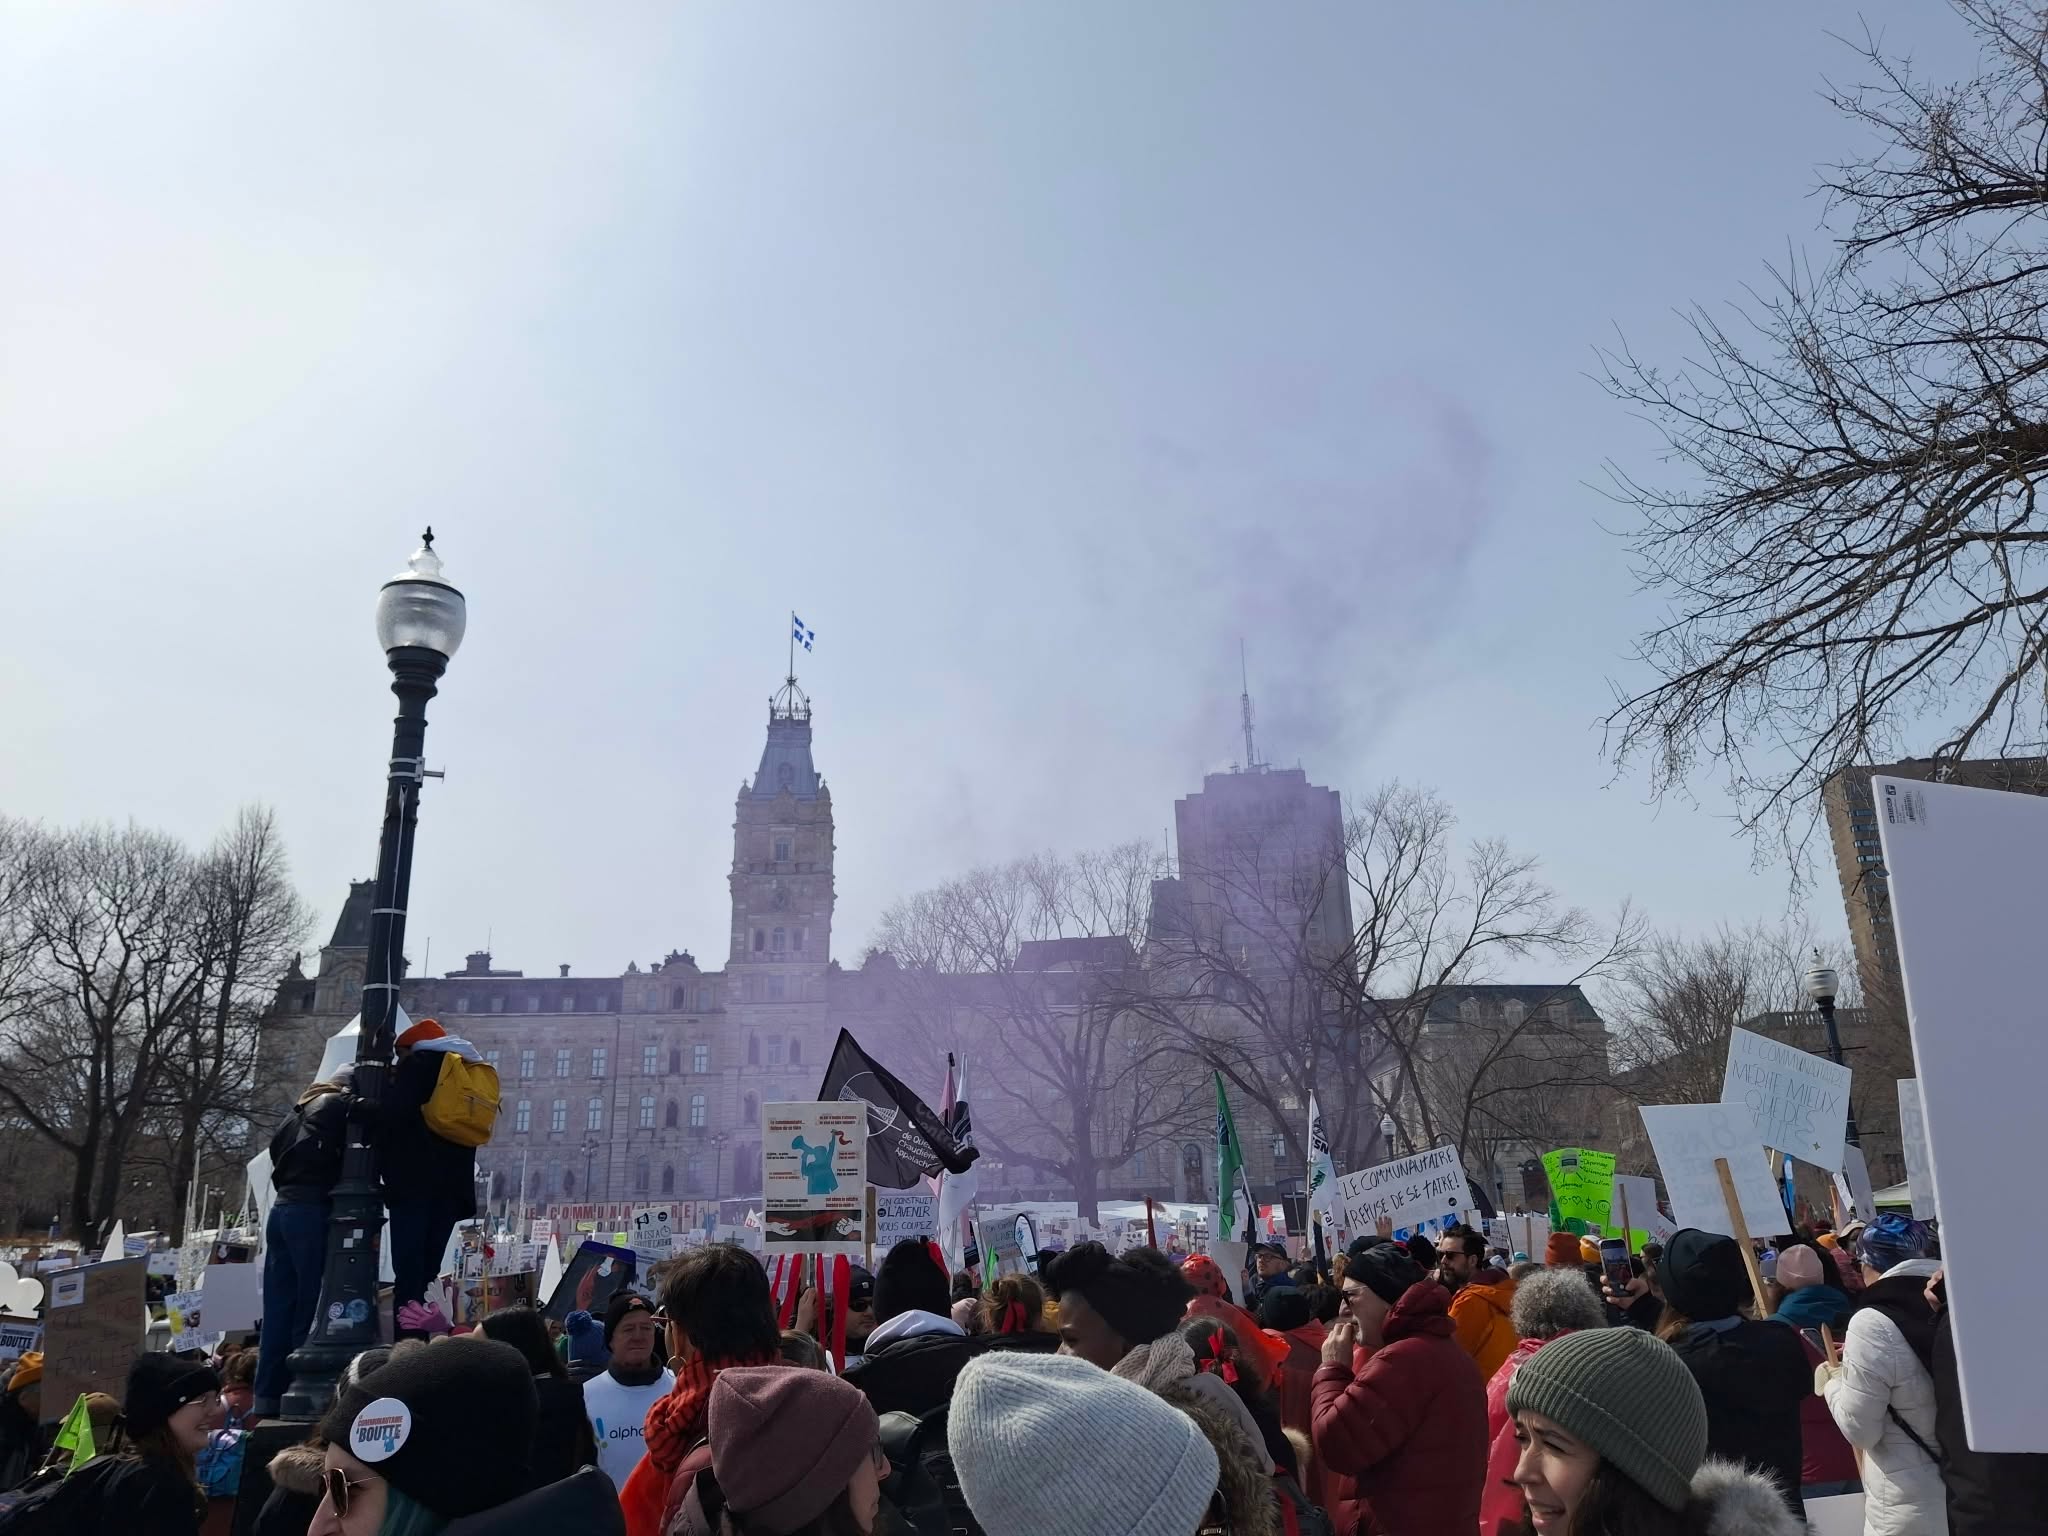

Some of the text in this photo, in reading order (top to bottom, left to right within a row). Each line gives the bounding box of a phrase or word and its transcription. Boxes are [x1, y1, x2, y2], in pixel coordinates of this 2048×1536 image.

[1785, 1079, 1841, 1119] MIEUX
[1343, 1177, 1361, 1201] LE
[1360, 1147, 1454, 1191] COMMUNAUTAIRE
[879, 1196, 933, 1207] ON CONSTRUIT
[1349, 1198, 1389, 1231] REFUSE
[1390, 1191, 1405, 1210] DE
[1405, 1185, 1422, 1202] SE
[525, 1207, 536, 1220] LE
[887, 1205, 931, 1218] L'AVENIR
[877, 1220, 933, 1232] VOUS COUPEZ
